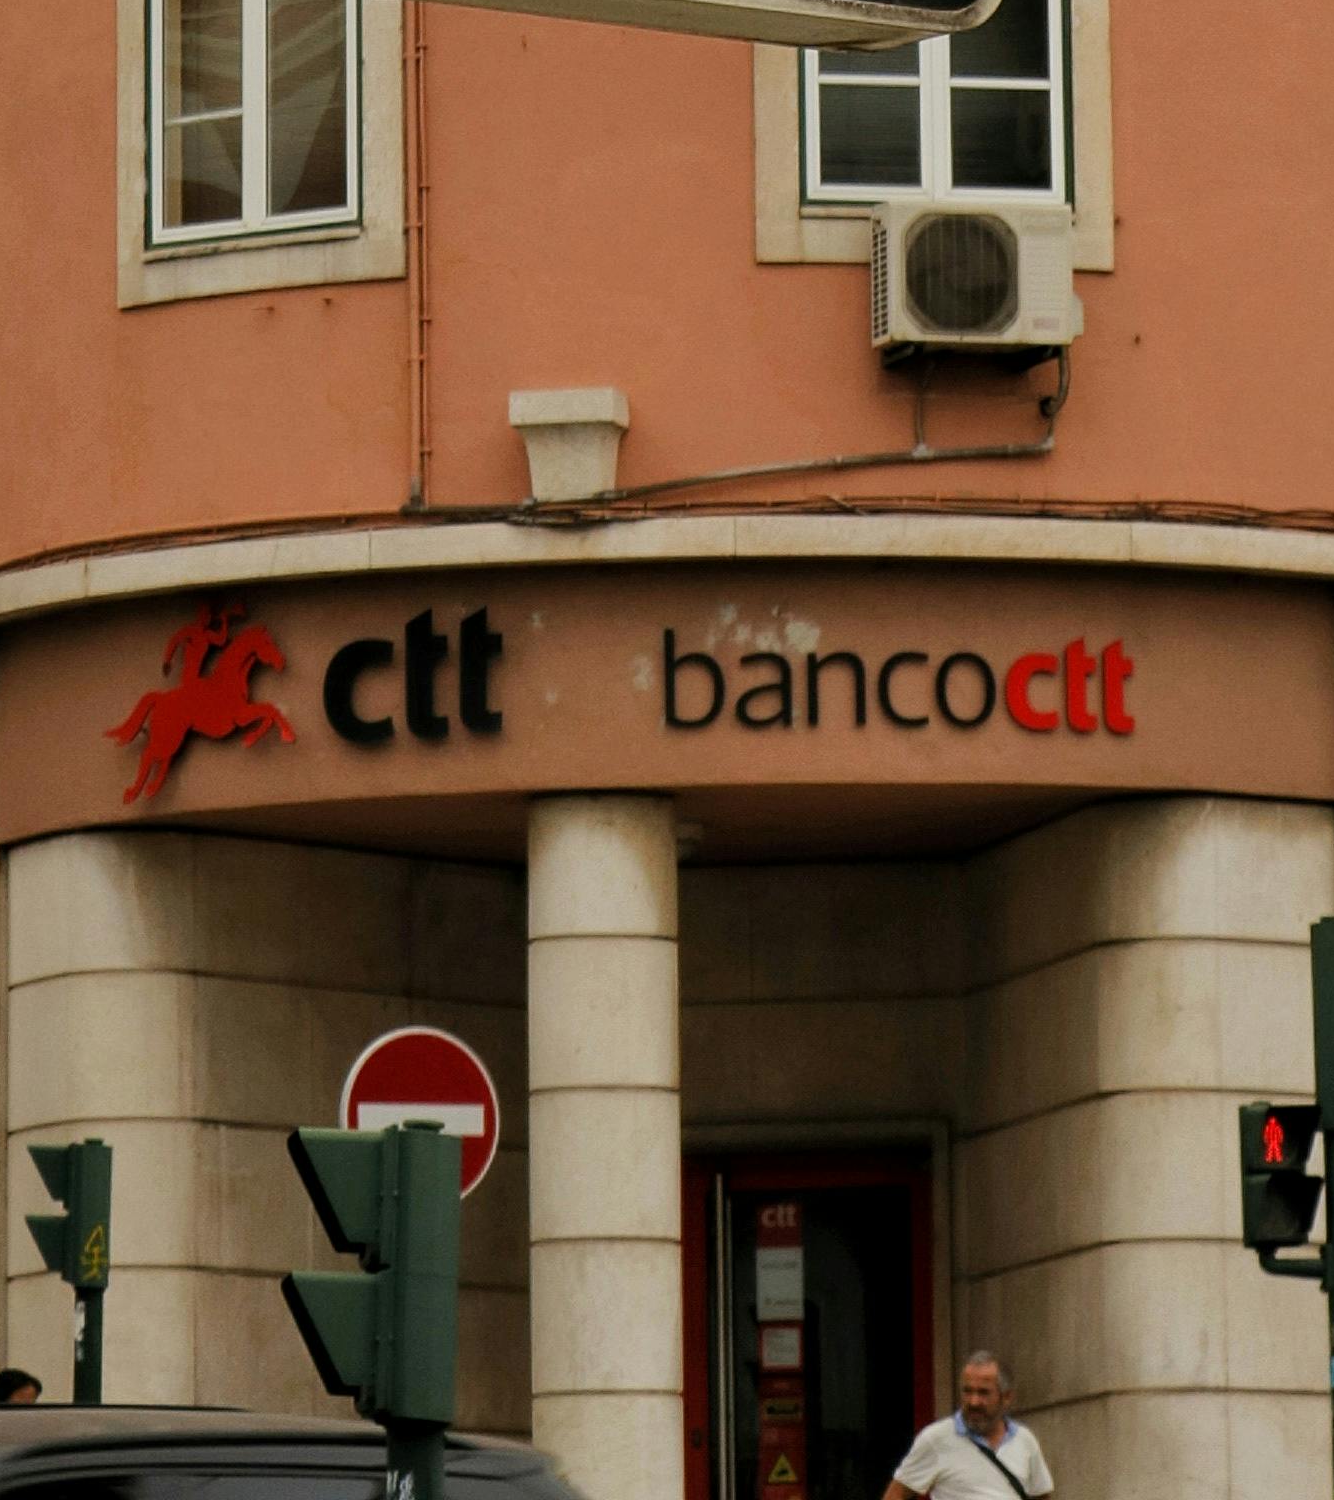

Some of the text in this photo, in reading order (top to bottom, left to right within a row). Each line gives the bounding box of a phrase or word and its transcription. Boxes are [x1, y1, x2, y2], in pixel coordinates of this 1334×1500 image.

[323, 606, 1136, 745] ctt bancoctt
[761, 1204, 798, 1230] ctt
